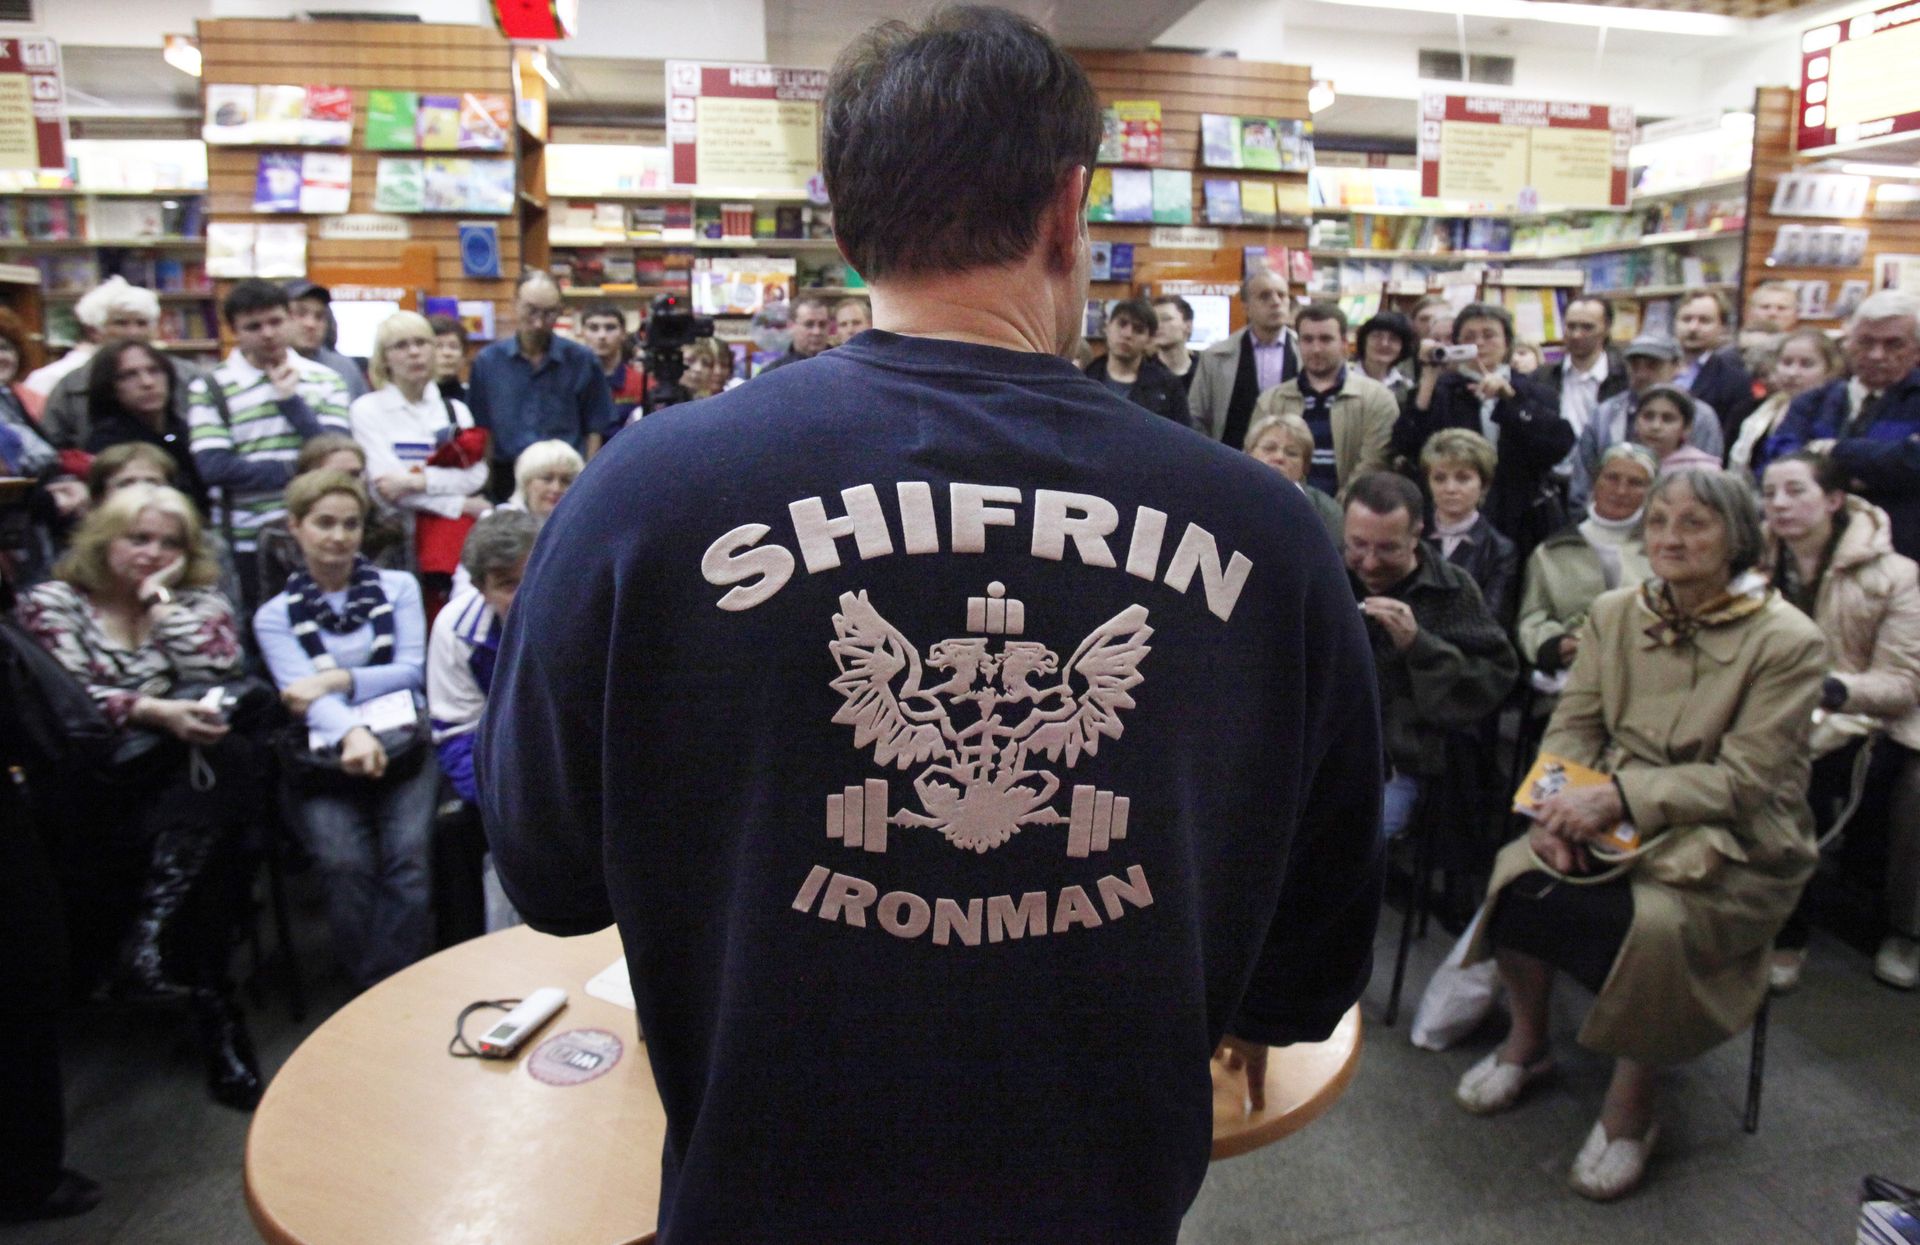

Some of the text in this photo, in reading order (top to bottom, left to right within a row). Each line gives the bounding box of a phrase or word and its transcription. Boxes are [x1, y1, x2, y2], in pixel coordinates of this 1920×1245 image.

[1161, 283, 1240, 297] НАВИГАТОР
[701, 481, 1253, 622] SHIFRIN
[791, 864, 1154, 946] IRONMAN
